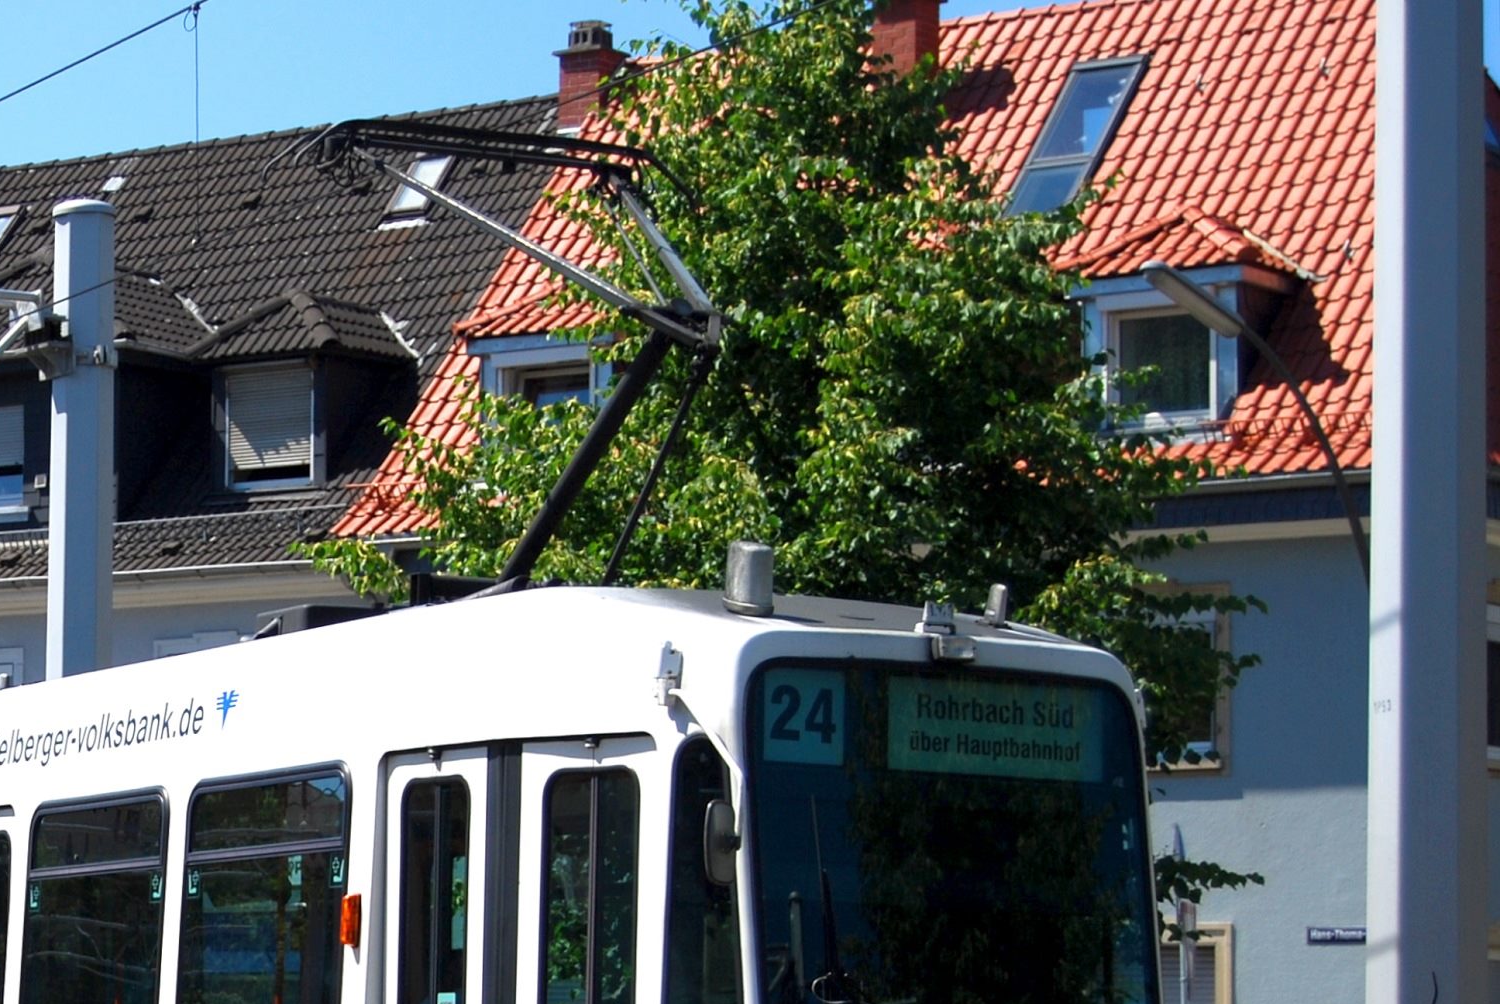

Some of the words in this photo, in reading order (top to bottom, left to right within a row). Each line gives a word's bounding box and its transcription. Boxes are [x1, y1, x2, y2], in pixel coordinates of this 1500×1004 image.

[769, 684, 837, 744] 24
[916, 693, 1025, 725] Rohrbach
[1032, 701, 1075, 729] Süd
[909, 730, 950, 752] über
[956, 733, 1081, 762] Hauptbahnhof
